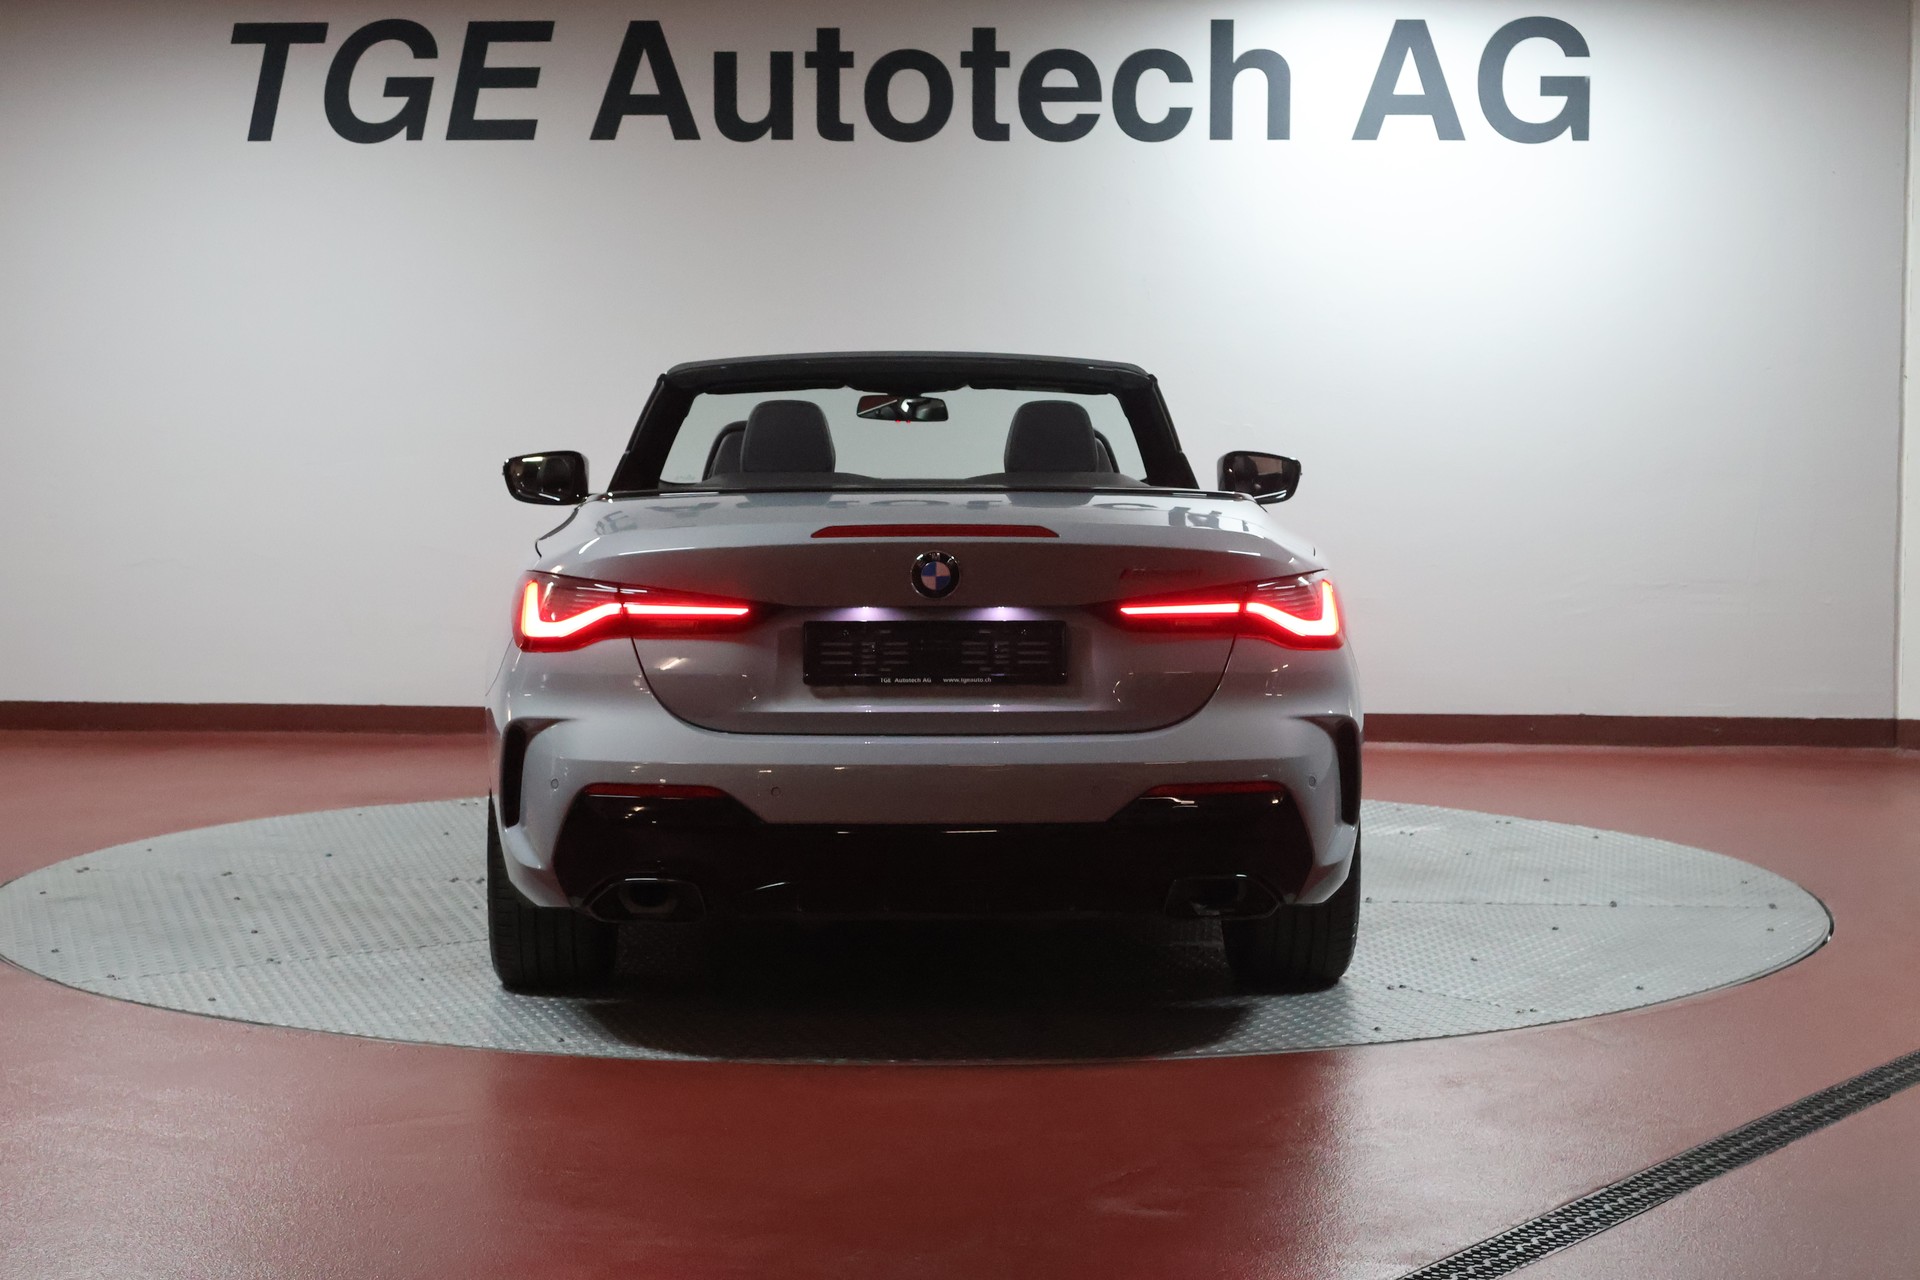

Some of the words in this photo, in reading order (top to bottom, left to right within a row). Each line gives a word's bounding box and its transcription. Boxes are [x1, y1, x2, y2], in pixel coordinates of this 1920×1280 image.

[230, 18, 556, 144] TGE
[589, 19, 1291, 143] Autotech
[1351, 15, 1591, 144] AG
